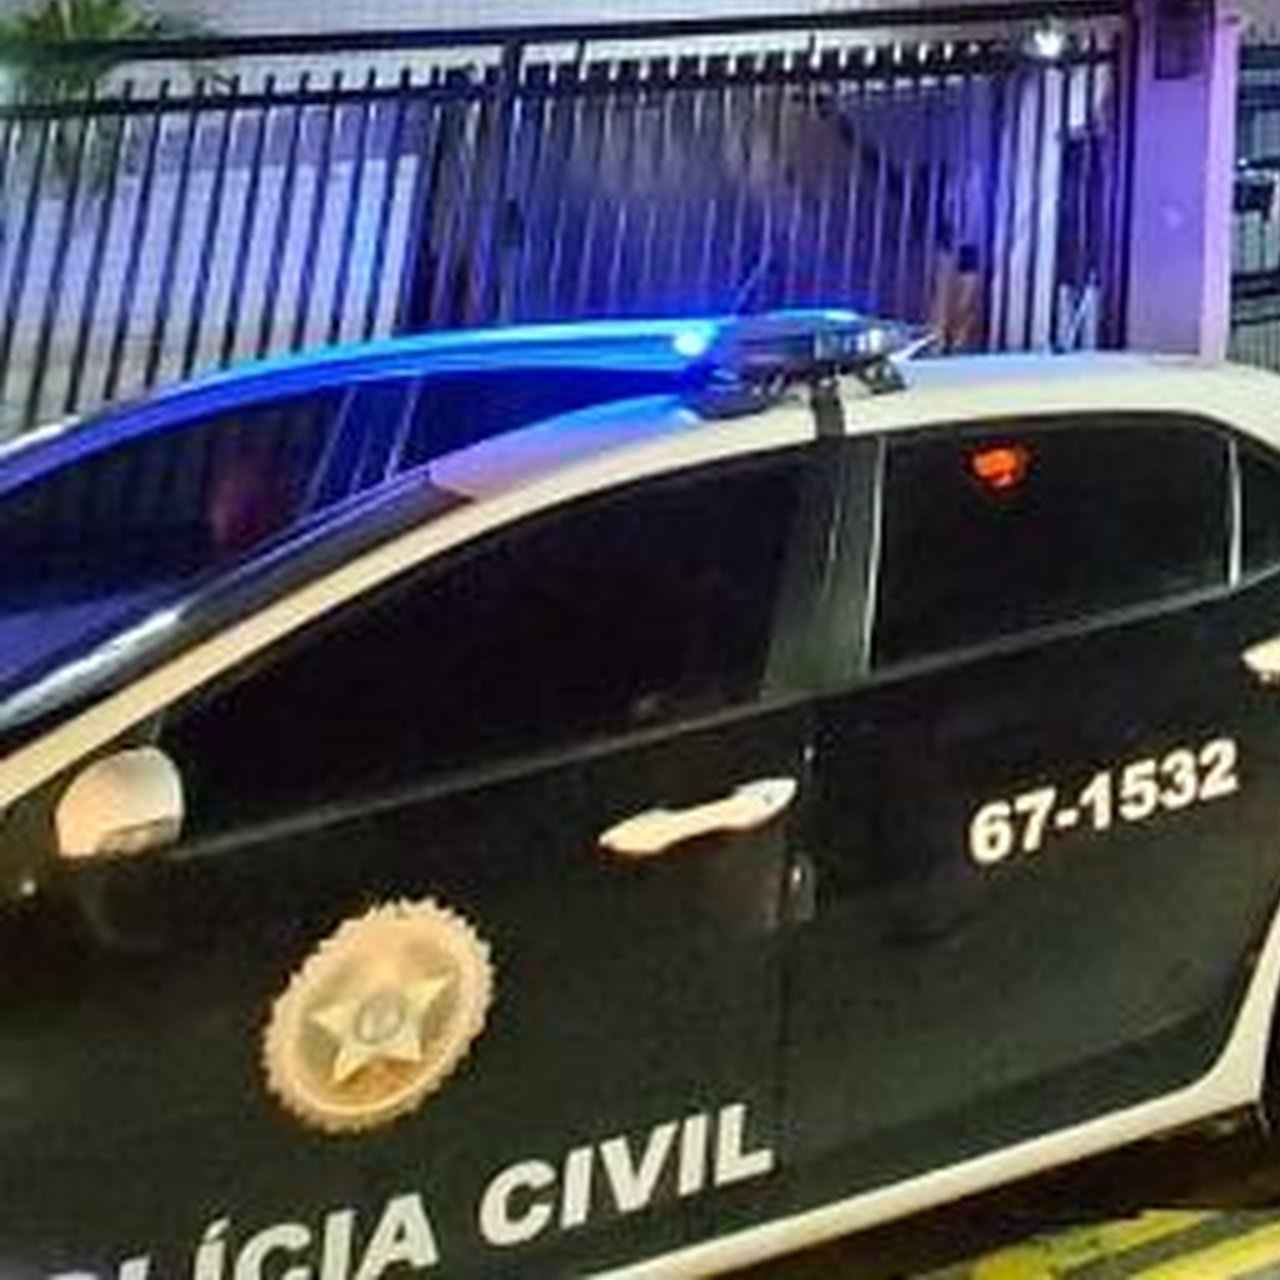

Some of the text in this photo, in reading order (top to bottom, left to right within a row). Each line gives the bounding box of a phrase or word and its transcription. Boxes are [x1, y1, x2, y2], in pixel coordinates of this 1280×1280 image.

[969, 738, 1239, 864] 67-1532
[47, 1103, 775, 1280] ÍCIA CIVIL
